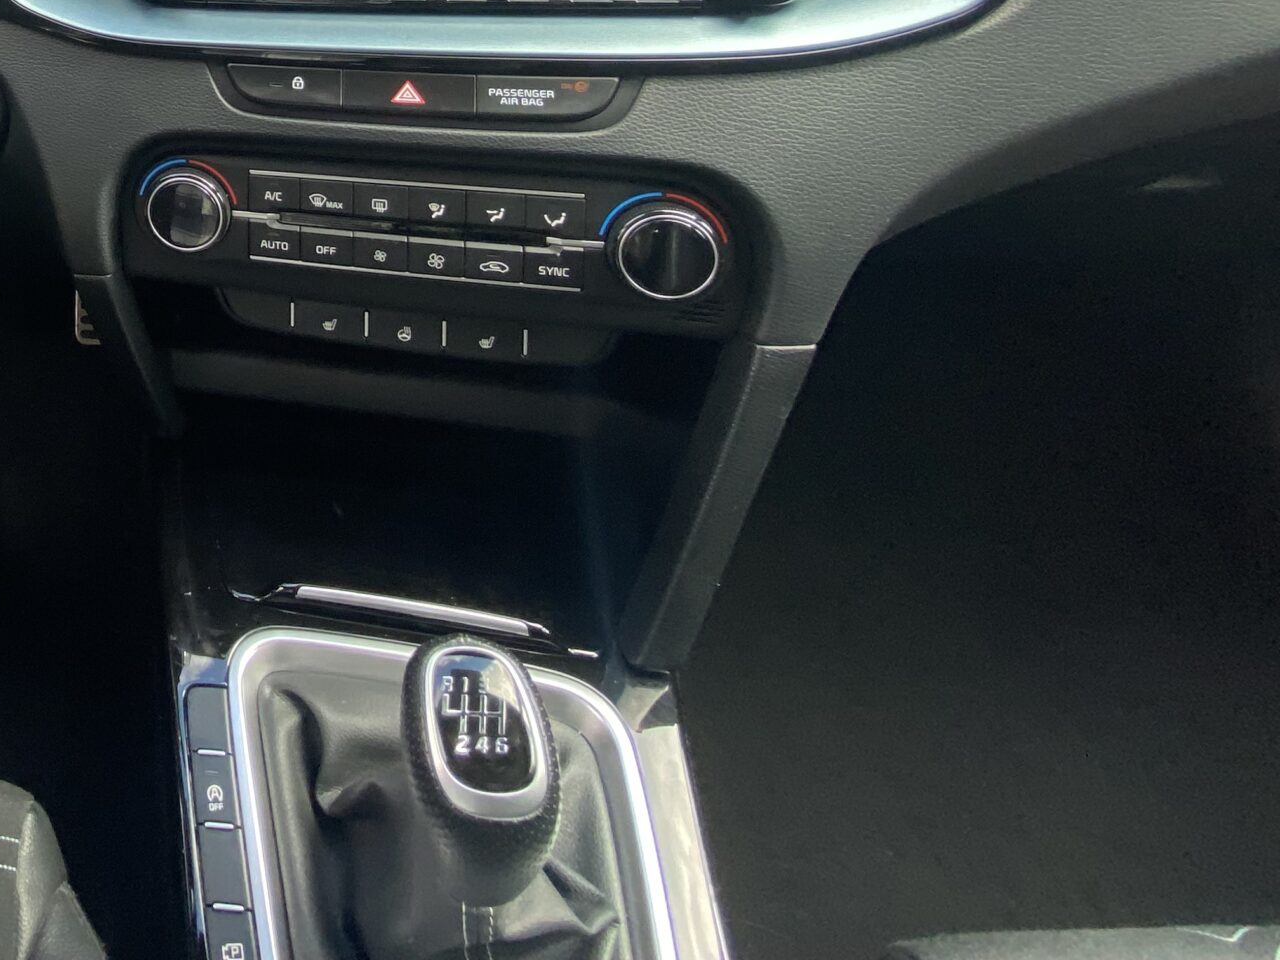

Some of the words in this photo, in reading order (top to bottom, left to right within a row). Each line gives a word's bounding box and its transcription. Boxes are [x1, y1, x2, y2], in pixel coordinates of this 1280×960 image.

[488, 88, 555, 99] PASSENGER
[500, 97, 519, 106] AIR
[521, 98, 544, 107] BAG
[264, 191, 283, 201] A/C
[325, 201, 343, 209] MAX
[260, 240, 289, 250] AUTO
[315, 245, 336, 255] OFF
[538, 265, 570, 277] SYNC
[441, 676, 453, 692] R
[455, 735, 470, 753] 2
[475, 736, 489, 754] 4
[495, 737, 509, 753] 6
[208, 802, 223, 811] OFF
